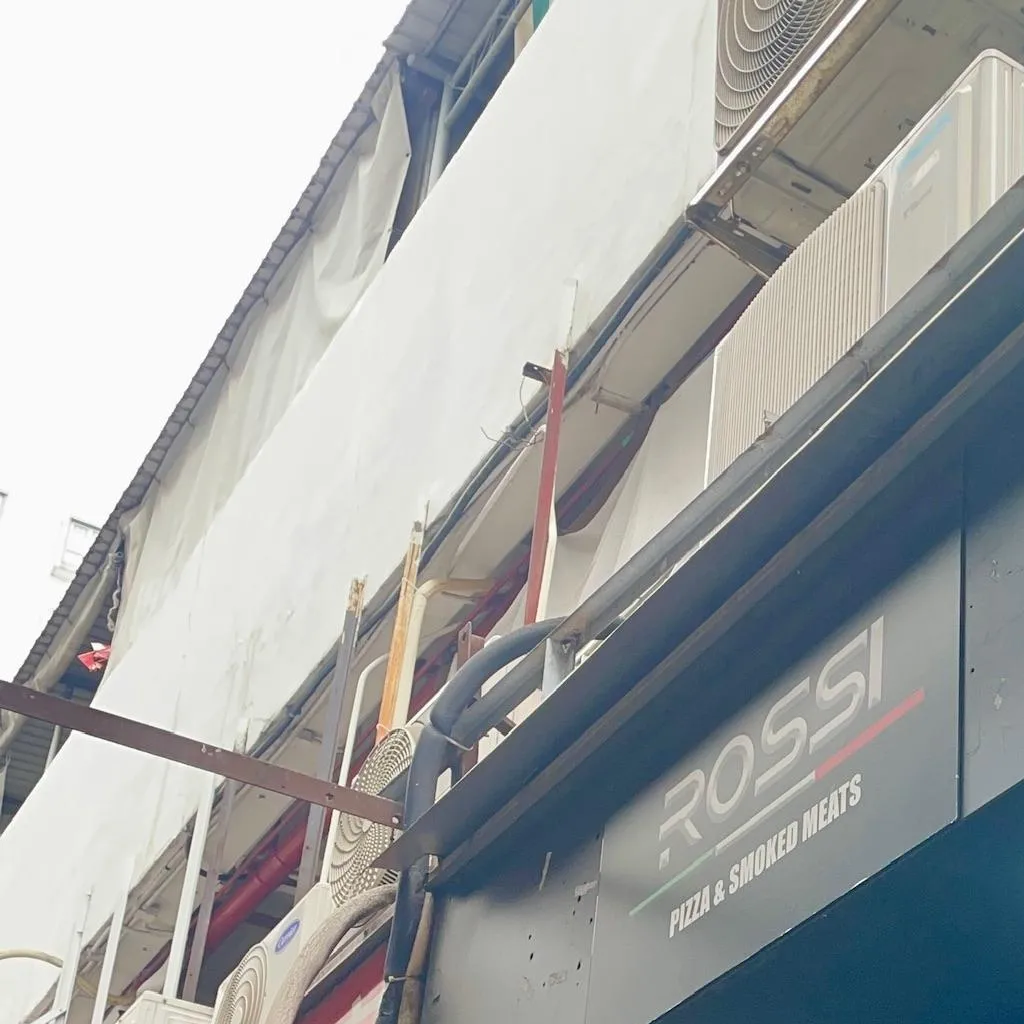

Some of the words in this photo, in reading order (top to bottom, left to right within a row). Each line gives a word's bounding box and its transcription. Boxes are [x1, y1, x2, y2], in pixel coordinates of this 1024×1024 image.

[659, 616, 884, 871] ROSSI
[669, 884, 711, 938] PIZZA
[713, 880, 725, 906] &
[729, 820, 798, 895] SMOKED
[802, 774, 862, 843] MEATS
